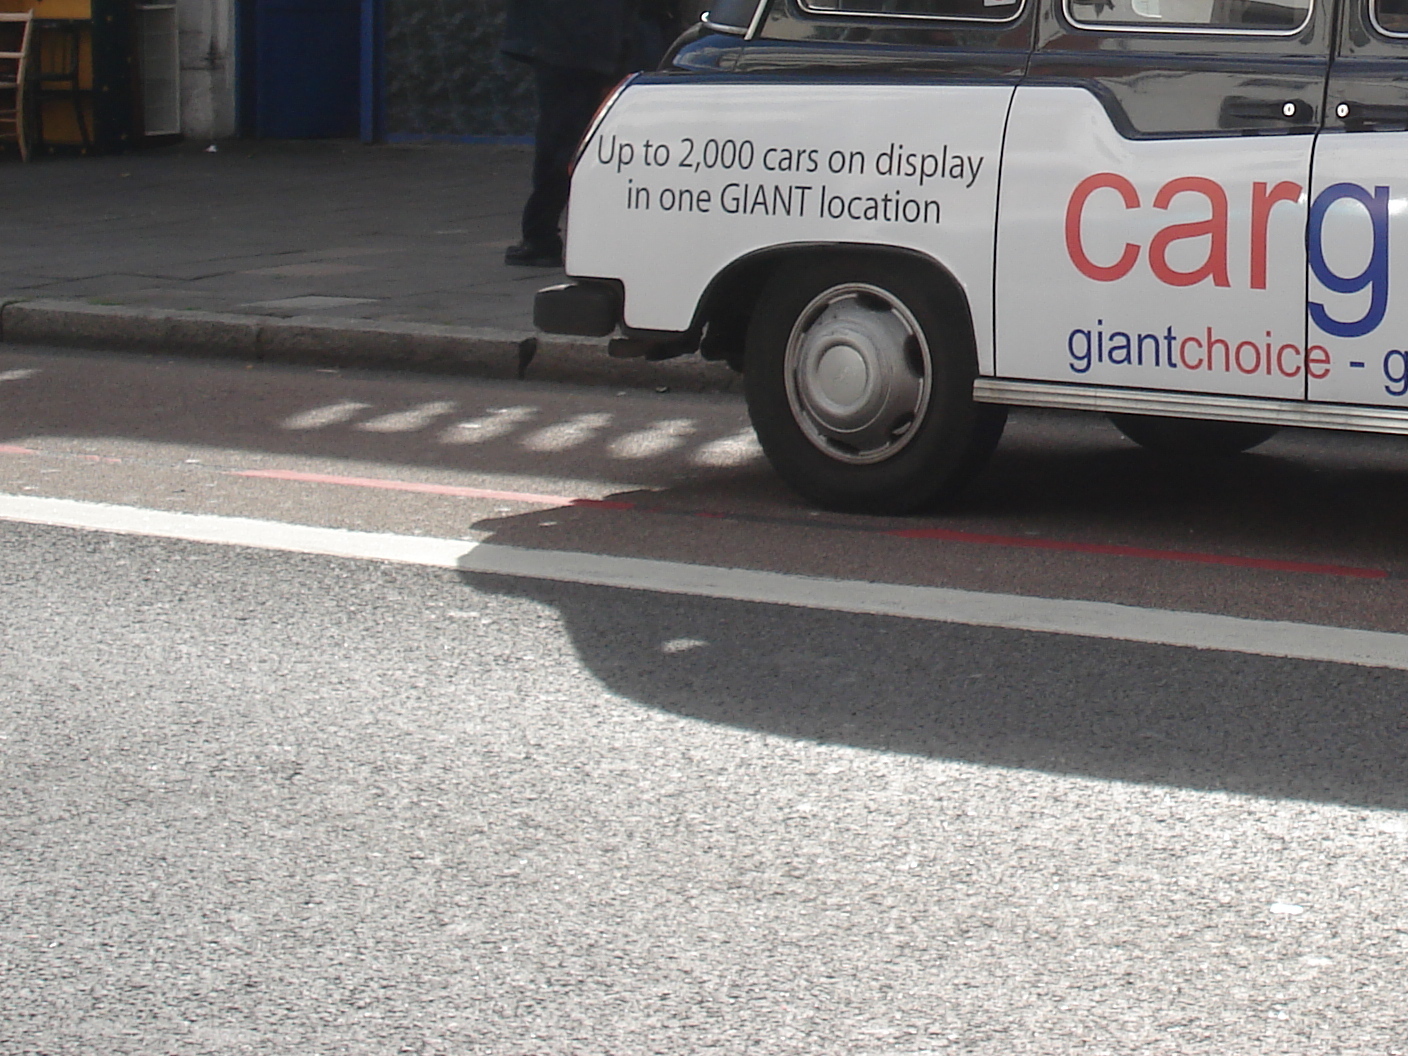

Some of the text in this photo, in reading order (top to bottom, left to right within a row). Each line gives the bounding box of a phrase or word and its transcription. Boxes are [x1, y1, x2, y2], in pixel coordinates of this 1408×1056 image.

[596, 134, 985, 189] Up to 2,000 cars on display
[626, 178, 941, 224] in one GIANT location
[1067, 319, 1332, 379] giantchoice
